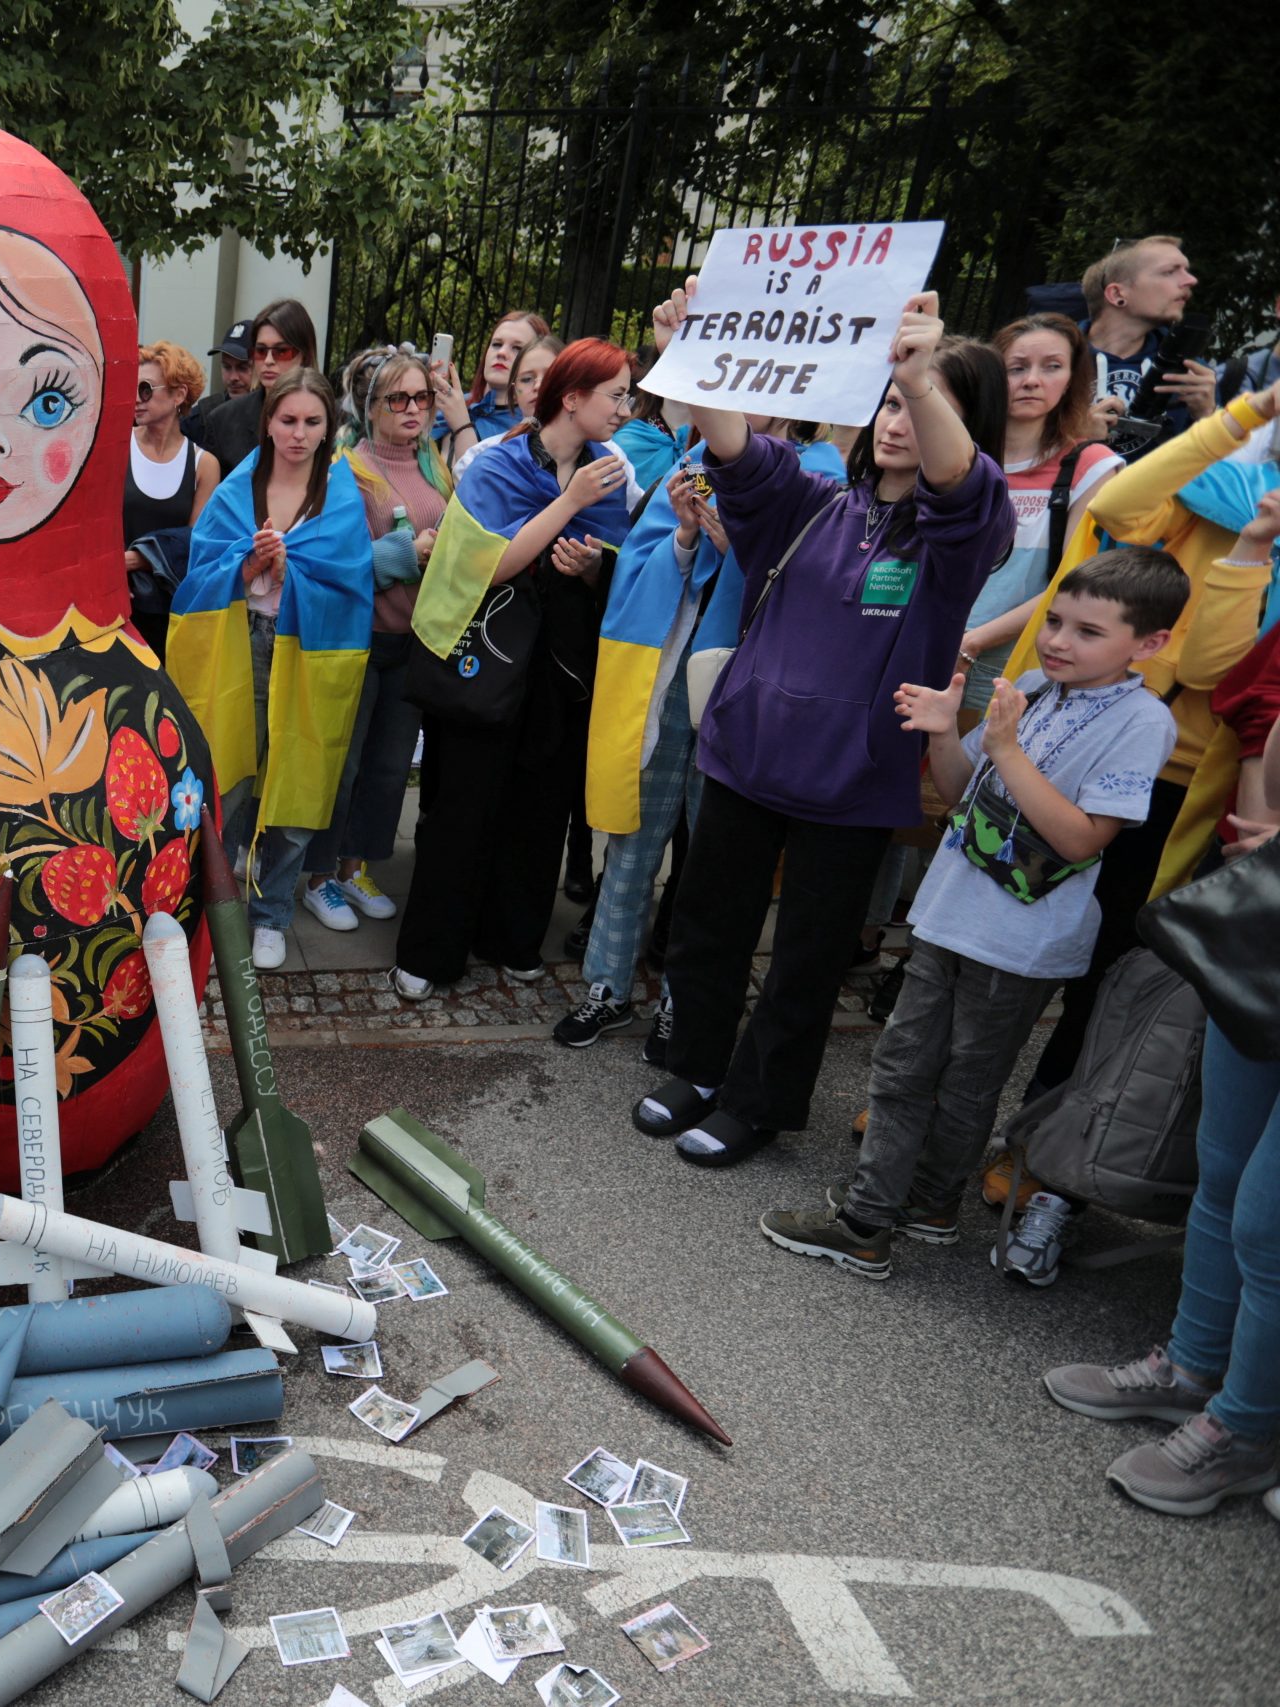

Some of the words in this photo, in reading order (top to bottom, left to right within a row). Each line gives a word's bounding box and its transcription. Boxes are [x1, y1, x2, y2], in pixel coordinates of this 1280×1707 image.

[805, 274, 822, 296] A
[696, 352, 818, 396] STATE
[1015, 506, 1045, 517] APPY
[871, 574, 902, 582] Partner
[873, 566, 913, 575] Microsoft
[869, 583, 905, 592] Network
[861, 608, 902, 617] UKRAINE
[239, 955, 257, 990] НА
[247, 994, 278, 1096] ОДЕССУ
[18, 1047, 39, 1082] НА
[85, 1233, 118, 1265] НА
[132, 1248, 239, 1296] НИКОЛАЕВ
